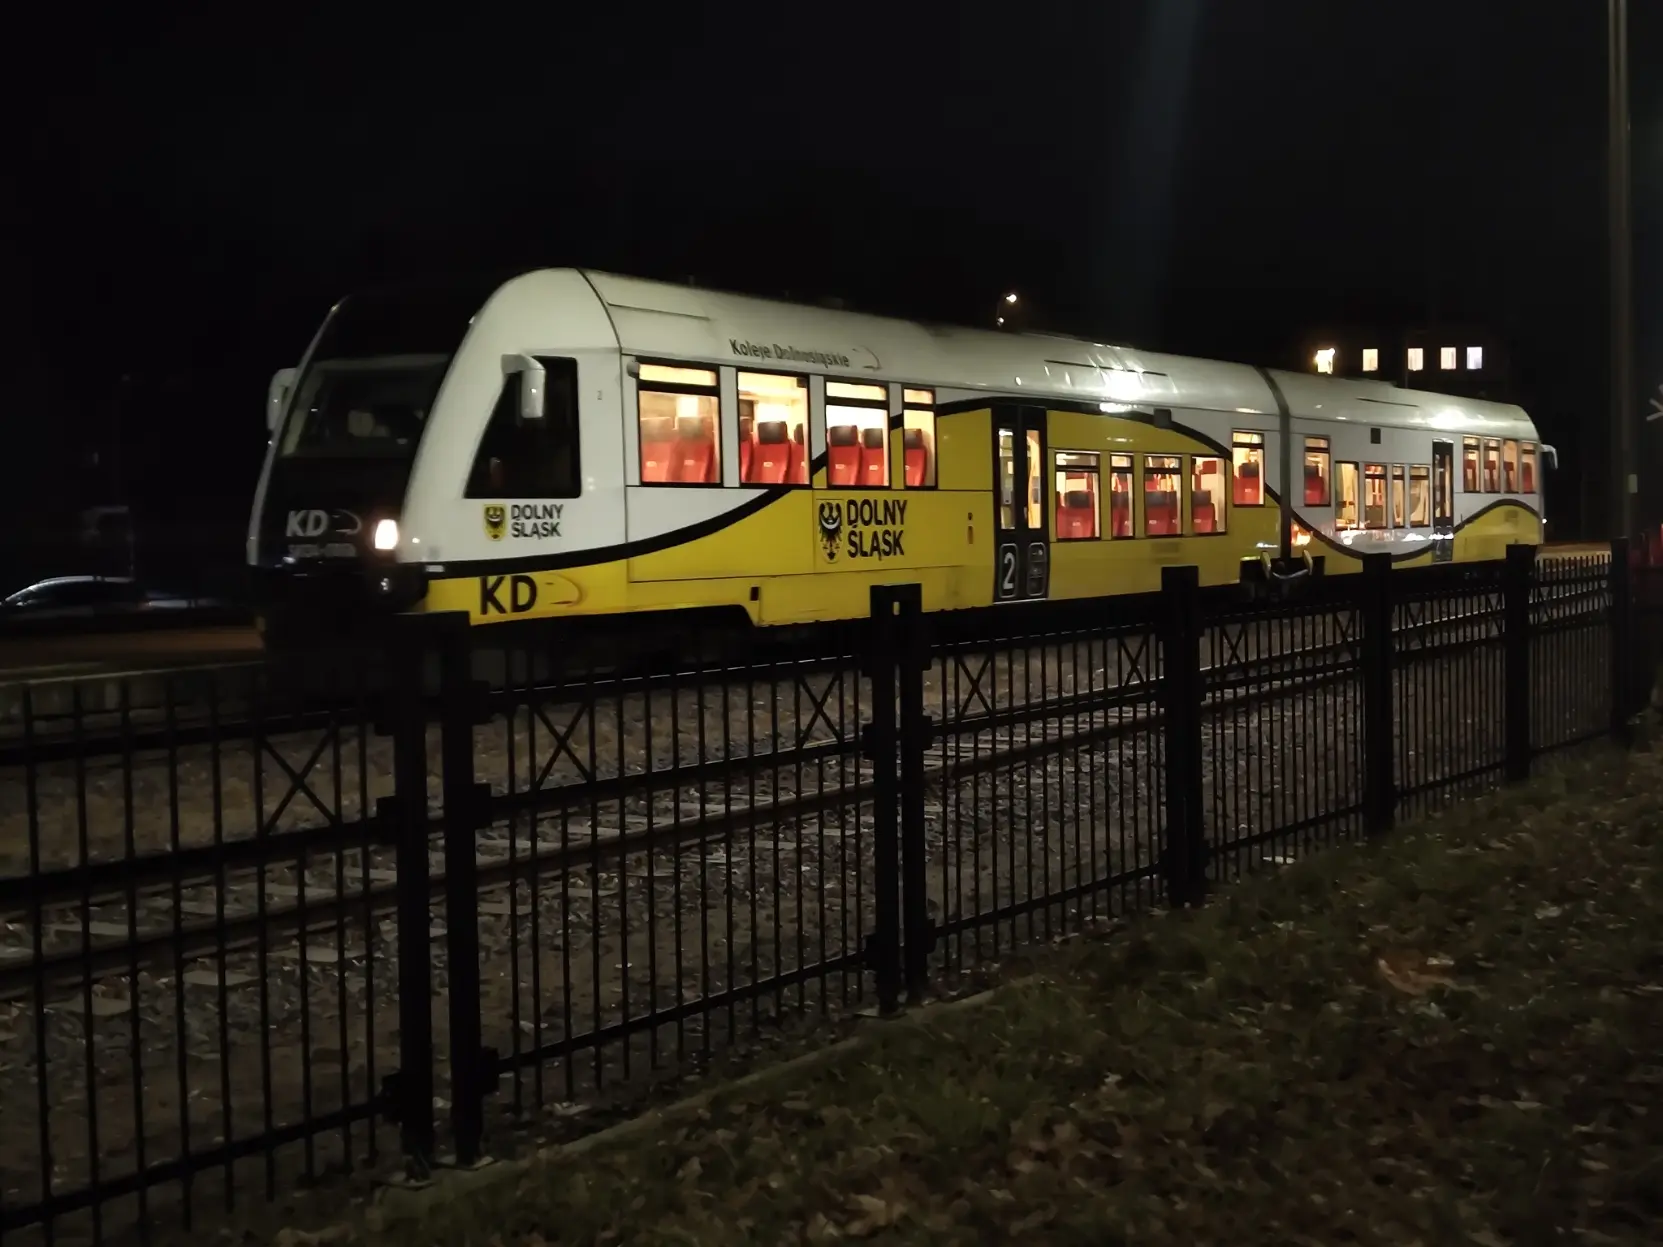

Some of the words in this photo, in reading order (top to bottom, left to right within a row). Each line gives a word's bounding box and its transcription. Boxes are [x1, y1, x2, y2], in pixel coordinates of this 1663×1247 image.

[729, 338, 771, 361] Koleje
[286, 509, 328, 537] KD
[511, 504, 564, 520] DOLNY
[846, 498, 908, 526] DOLNY
[846, 523, 905, 562] ŚLĄSK
[1003, 552, 1015, 590] 2
[480, 574, 538, 615] KD
